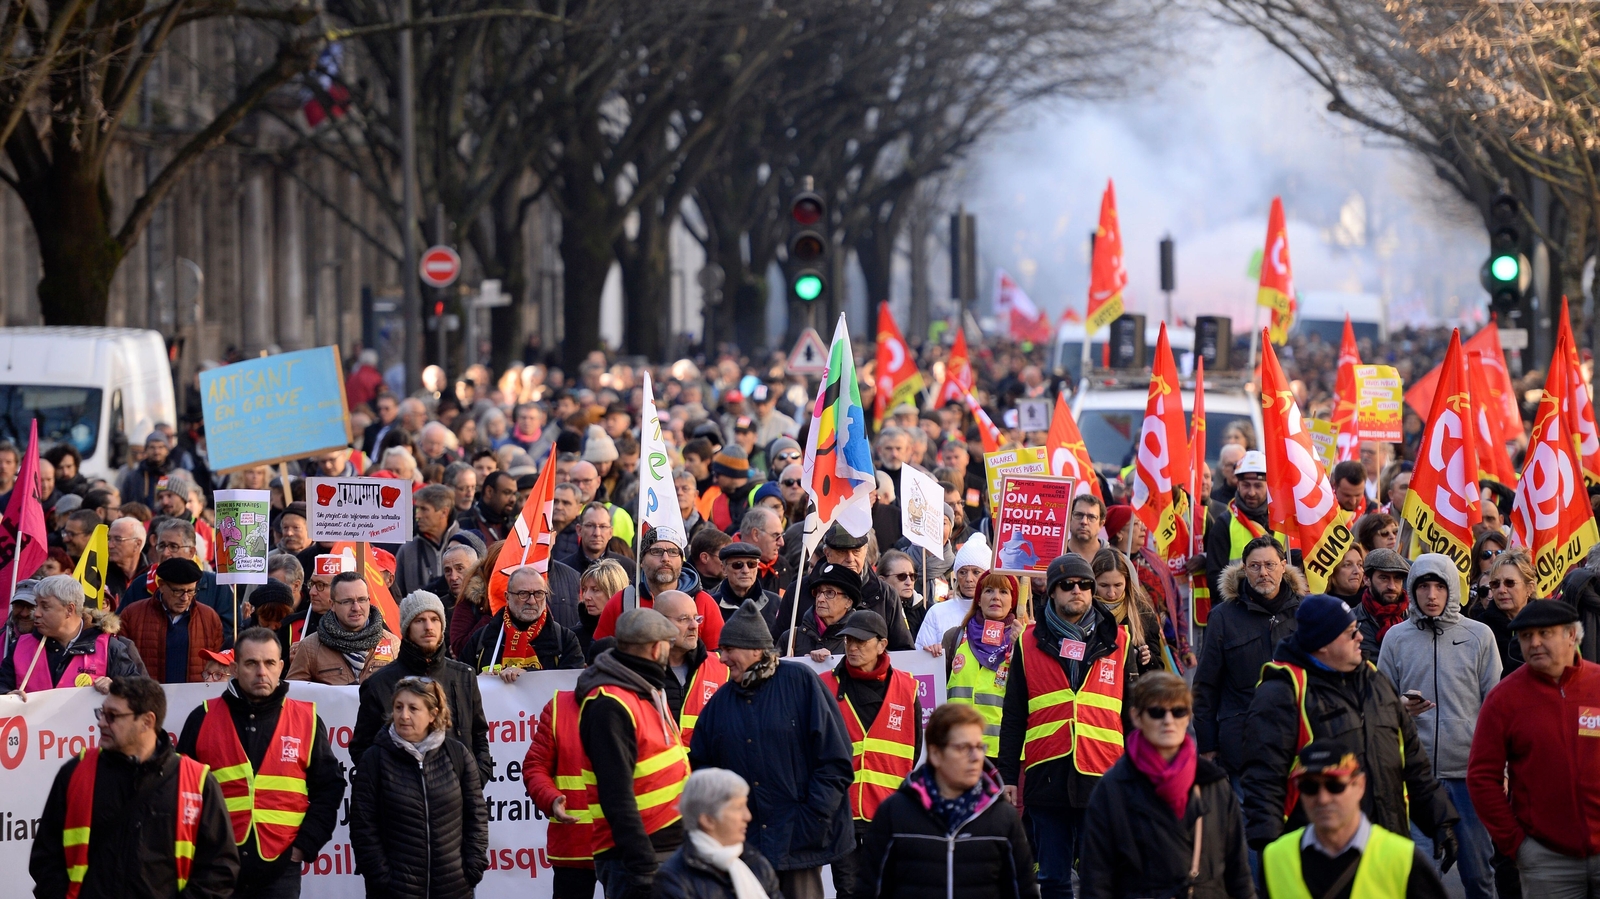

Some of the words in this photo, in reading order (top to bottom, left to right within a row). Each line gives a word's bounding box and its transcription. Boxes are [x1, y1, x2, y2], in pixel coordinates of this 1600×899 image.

[216, 404, 235, 422] EN
[990, 454, 1014, 466] SALAIRES
[1006, 492, 1028, 504] ON
[1031, 494, 1042, 505] A
[324, 512, 341, 520] projet
[1004, 508, 1043, 520] TOUT
[1045, 508, 1056, 522] À
[316, 522, 342, 530] saignant
[357, 522, 374, 530] points
[1002, 523, 1061, 537] PERDRE
[344, 530, 360, 538] temps
[368, 529, 380, 538] Non
[1168, 554, 1186, 568] cgt
[322, 562, 340, 574] cgt
[986, 628, 1000, 638] cgt
[375, 644, 392, 654] cgt
[1068, 650, 1082, 658] cgt
[1100, 670, 1115, 680] cgt
[889, 716, 902, 726] cgt
[8, 736, 19, 746] 33
[282, 748, 300, 759] cgt
